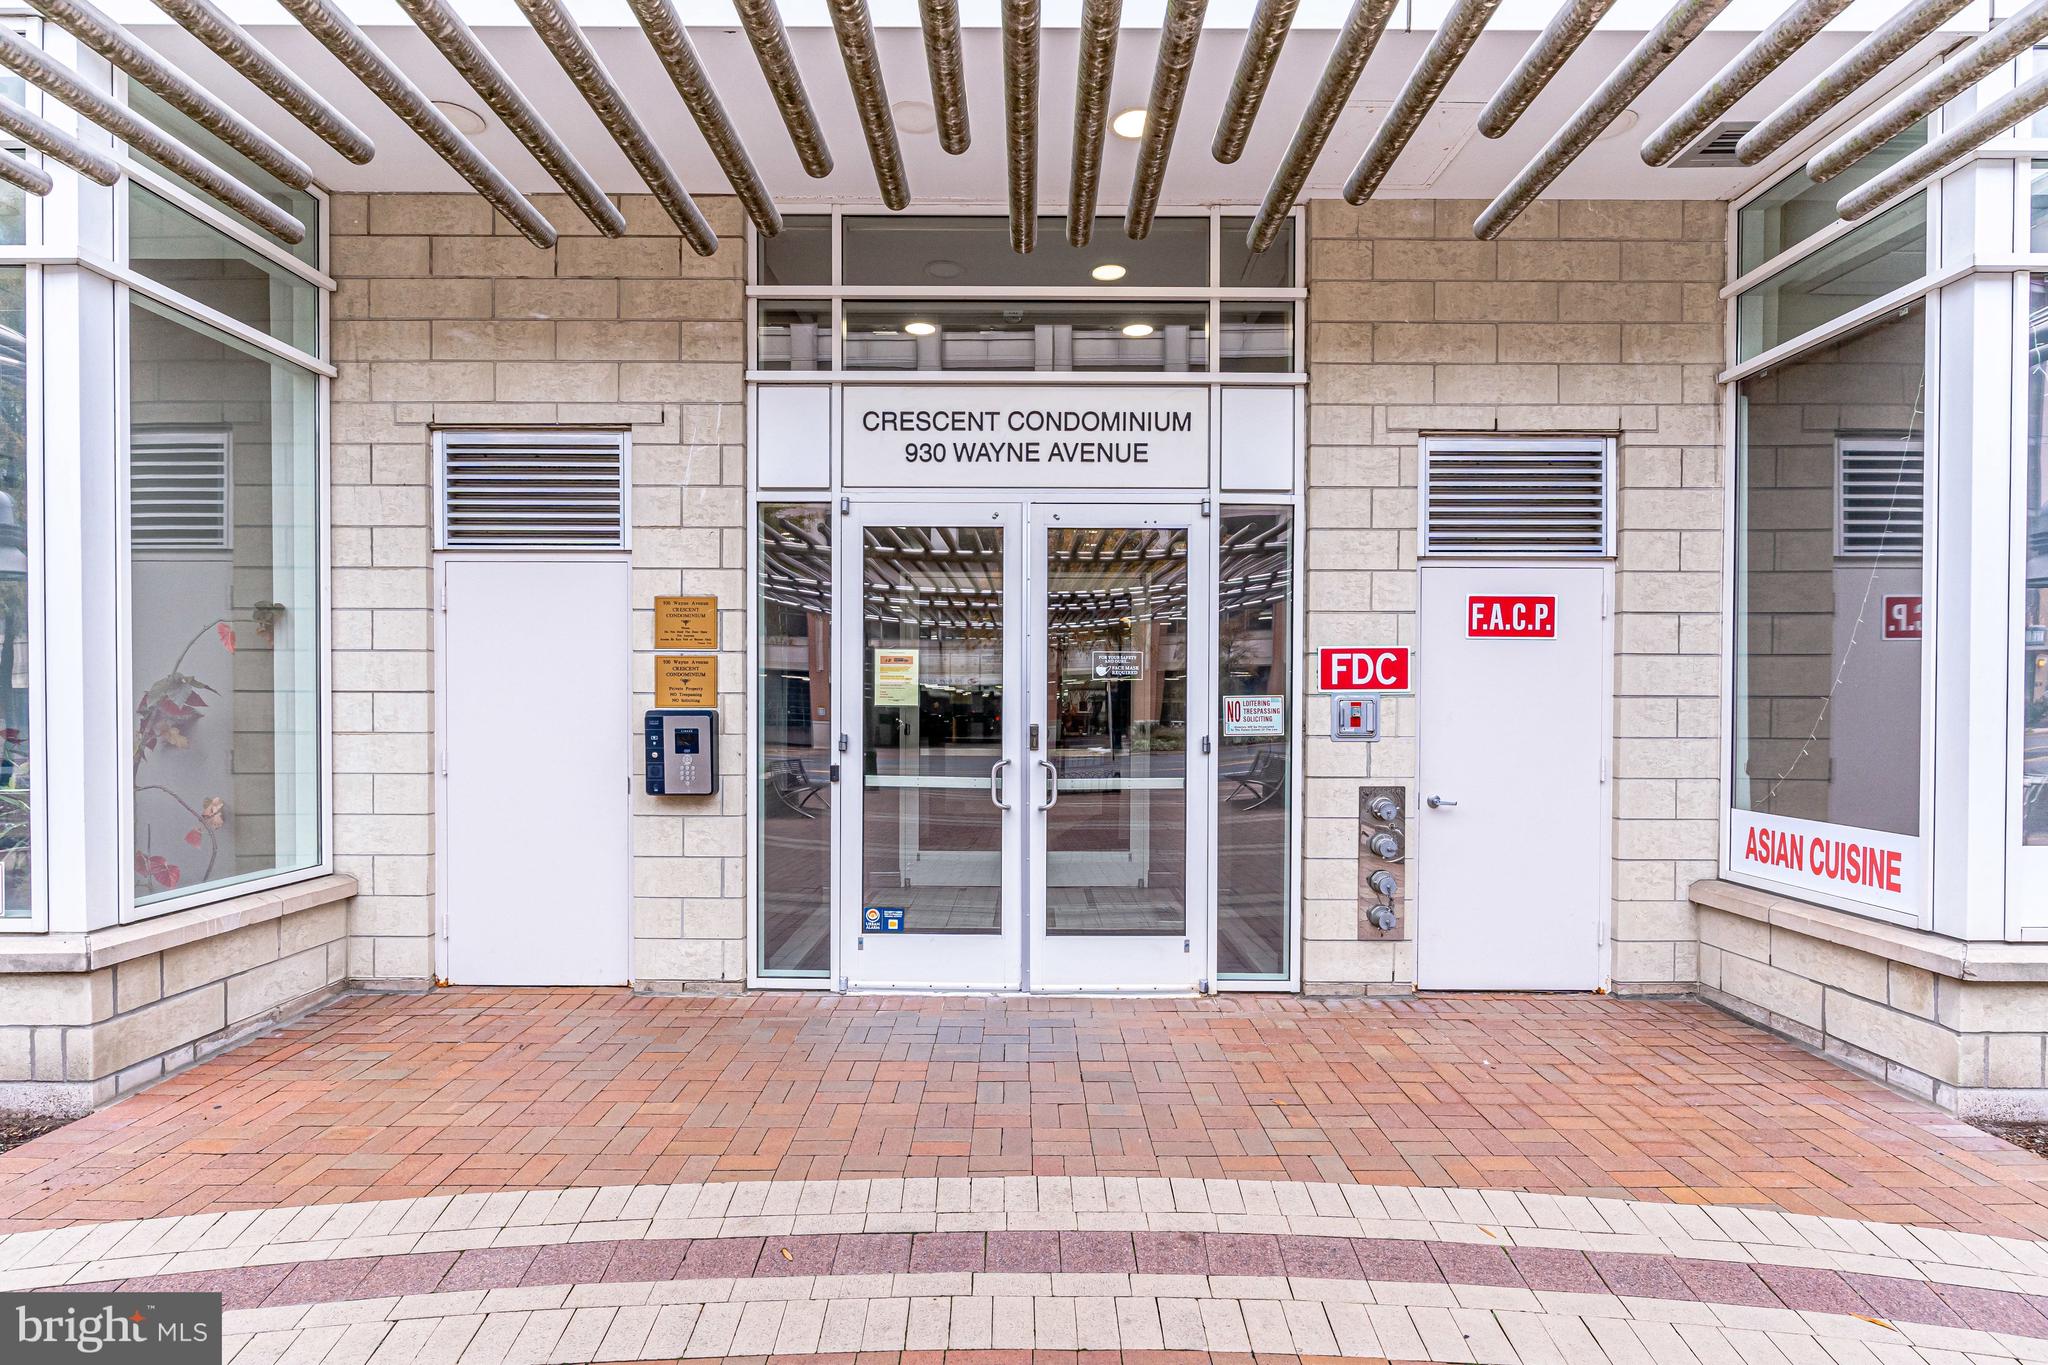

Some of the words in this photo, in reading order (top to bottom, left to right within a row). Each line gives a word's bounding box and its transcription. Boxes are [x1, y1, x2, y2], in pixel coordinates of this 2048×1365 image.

[862, 411, 1000, 432] CRESCENT
[1007, 410, 1192, 432] CONDOMINIUM
[905, 443, 947, 463] 930
[953, 443, 1040, 463] WAYNE
[1047, 443, 1149, 463] AVENUE
[1472, 603, 1551, 630] F.A.C.P.
[1331, 652, 1397, 685] FDC
[1227, 701, 1241, 722] NO
[1745, 826, 1804, 871] ASIAN
[1809, 837, 1902, 893] CUISINE
